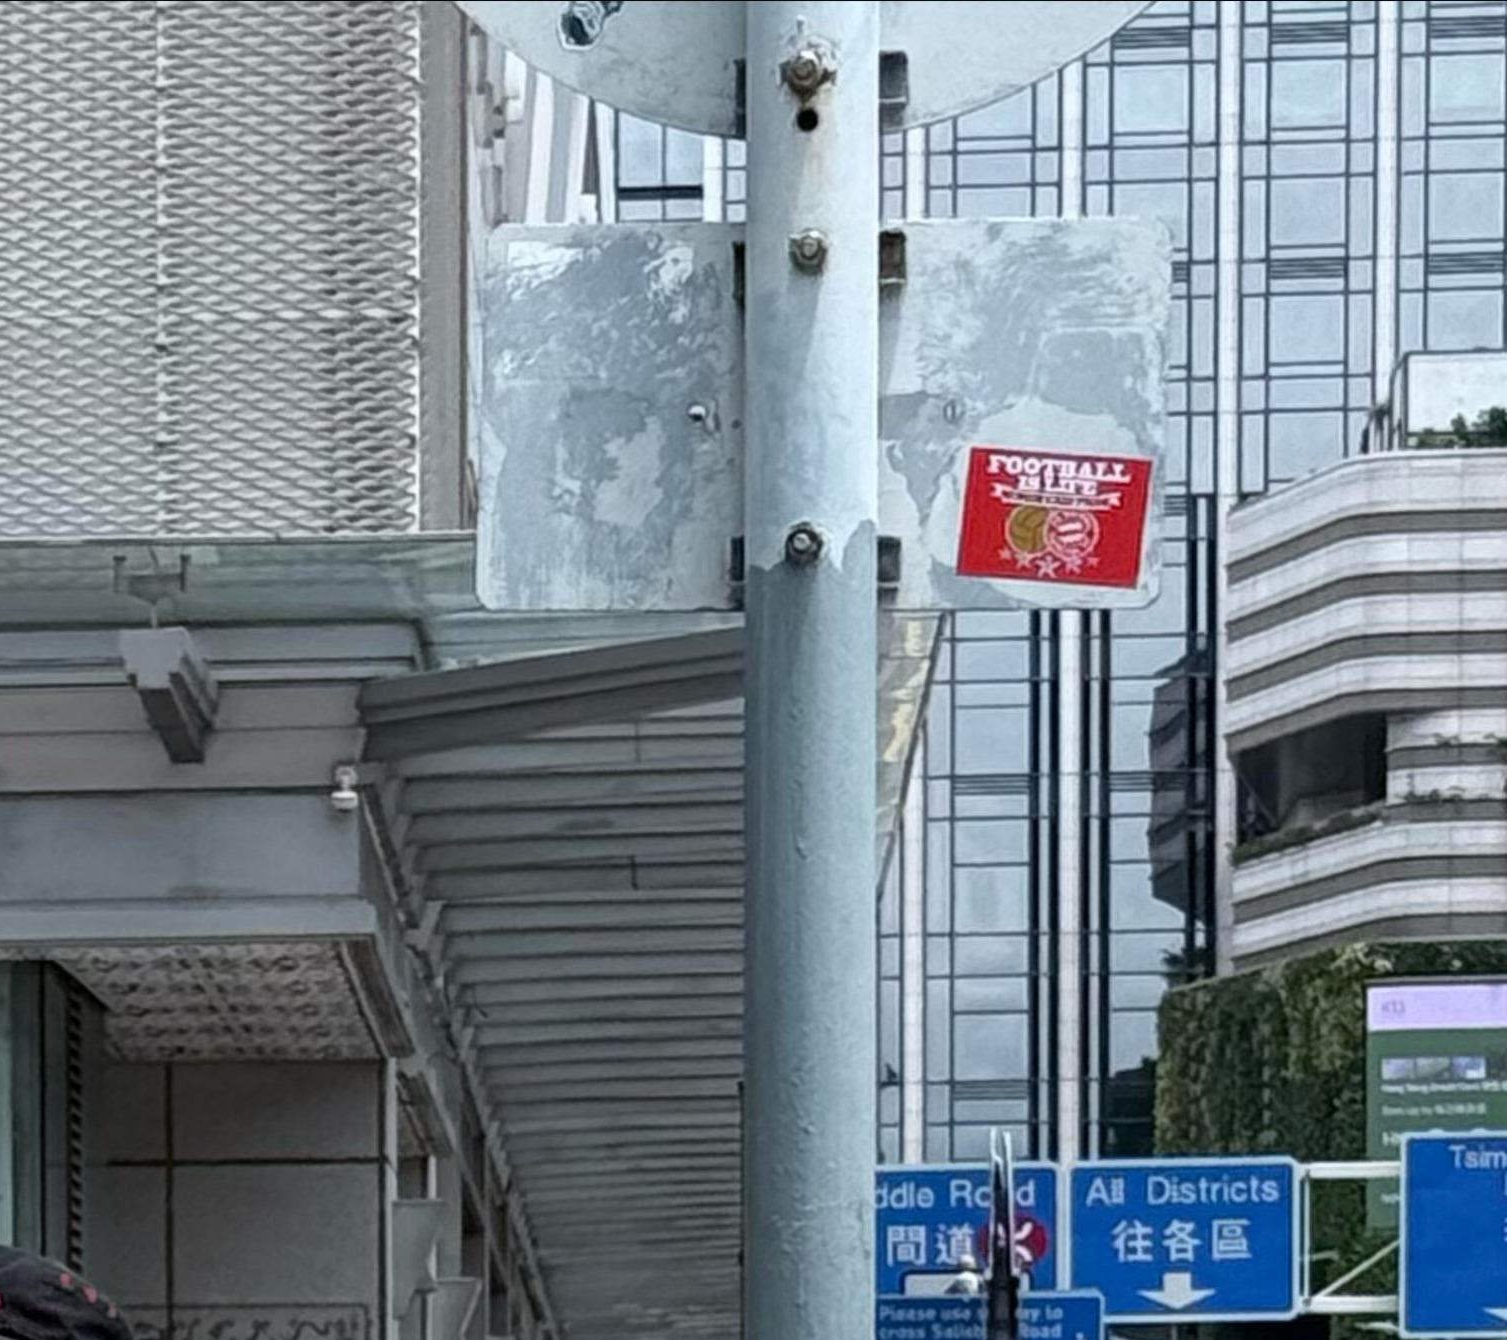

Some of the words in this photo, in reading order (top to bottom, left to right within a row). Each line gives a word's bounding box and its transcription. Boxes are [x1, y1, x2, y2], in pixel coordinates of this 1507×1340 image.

[987, 455, 1131, 483] FOOTBALL
[1018, 474, 1041, 491] IS
[1044, 476, 1097, 496] LIFE
[874, 1181, 935, 1210] ddle
[949, 1179, 1036, 1209] Rod
[1085, 1176, 1126, 1207] All
[1146, 1174, 1281, 1206] Districts
[886, 1222, 975, 1268] 間道
[1110, 1218, 1253, 1263] 往各區
[940, 1308, 972, 1322] use
[1045, 1304, 1064, 1320] to
[879, 1326, 926, 1340] cross
[1018, 1323, 1063, 1340] Road
